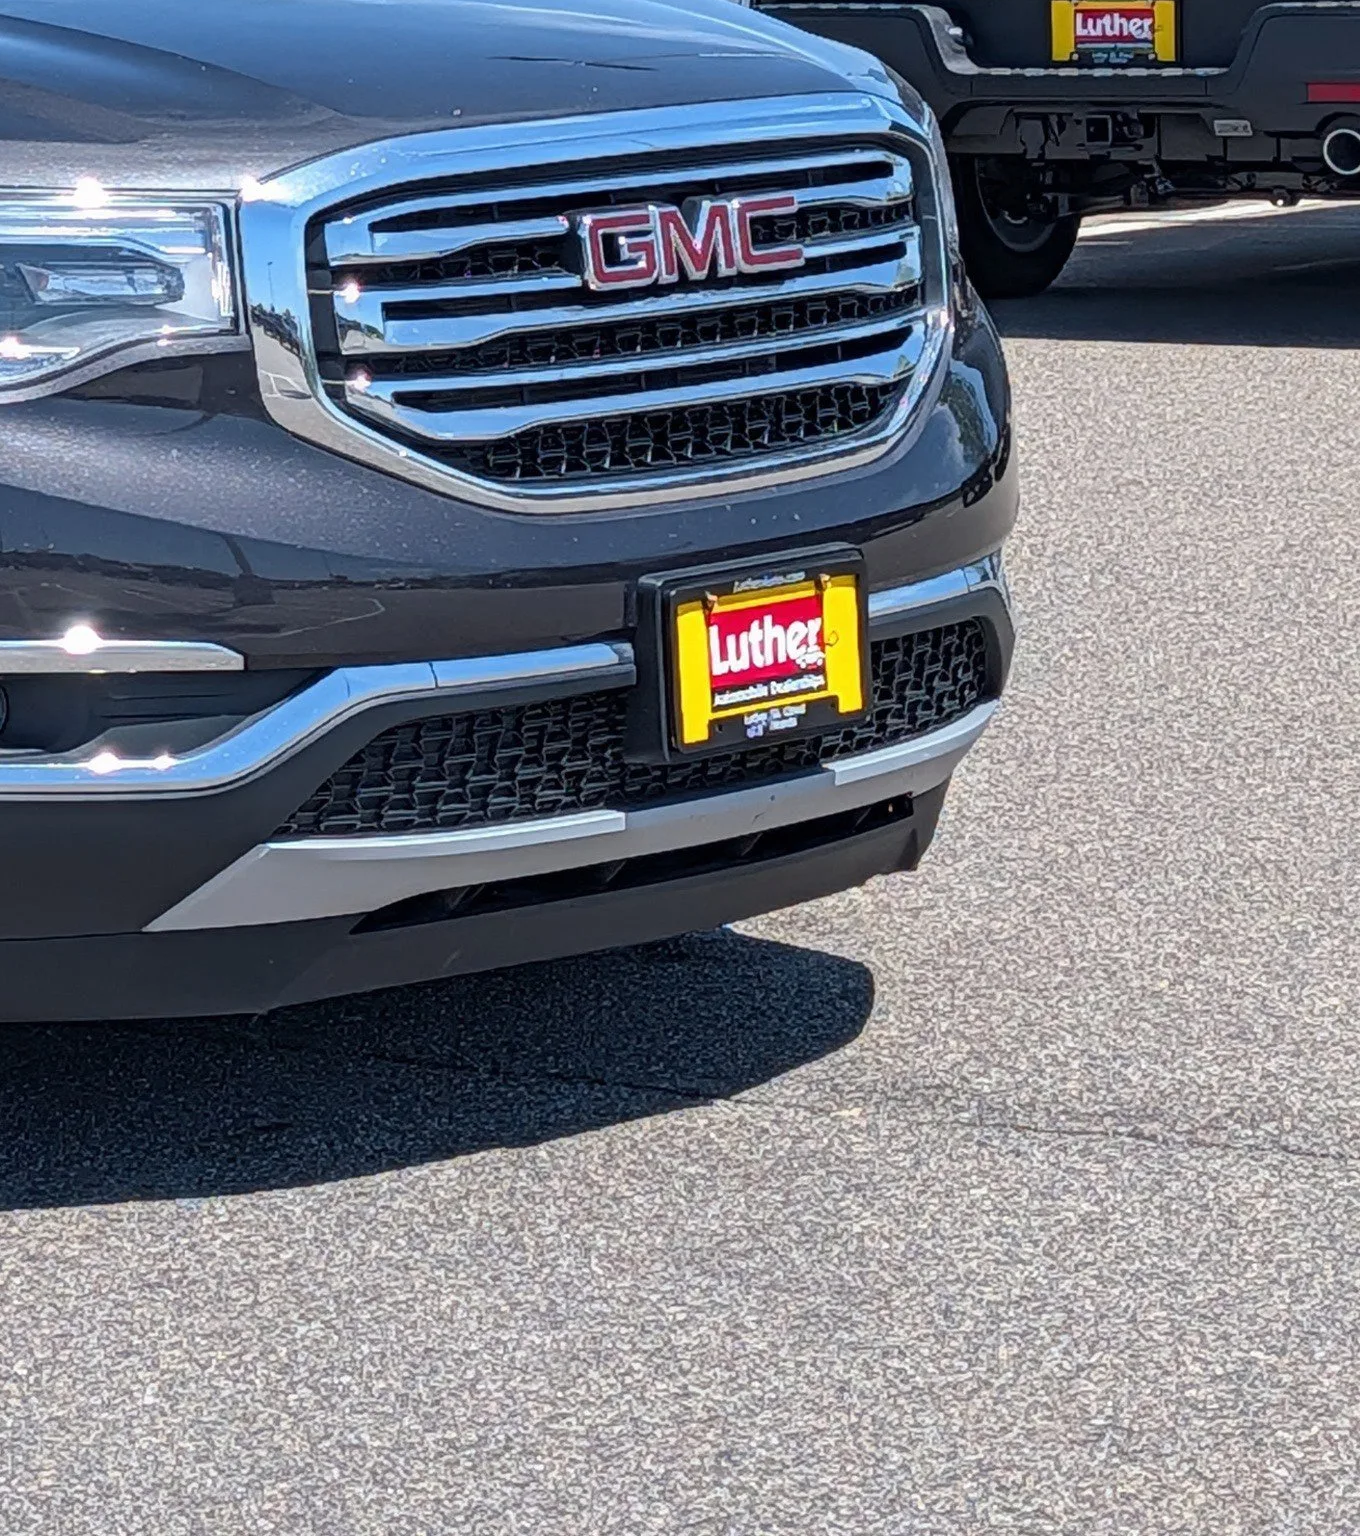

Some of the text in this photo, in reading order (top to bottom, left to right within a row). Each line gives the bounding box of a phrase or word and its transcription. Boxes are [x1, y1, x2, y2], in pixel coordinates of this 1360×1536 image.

[1075, 12, 1154, 37] Luther
[580, 195, 806, 292] GMC
[708, 614, 823, 677] Luther
